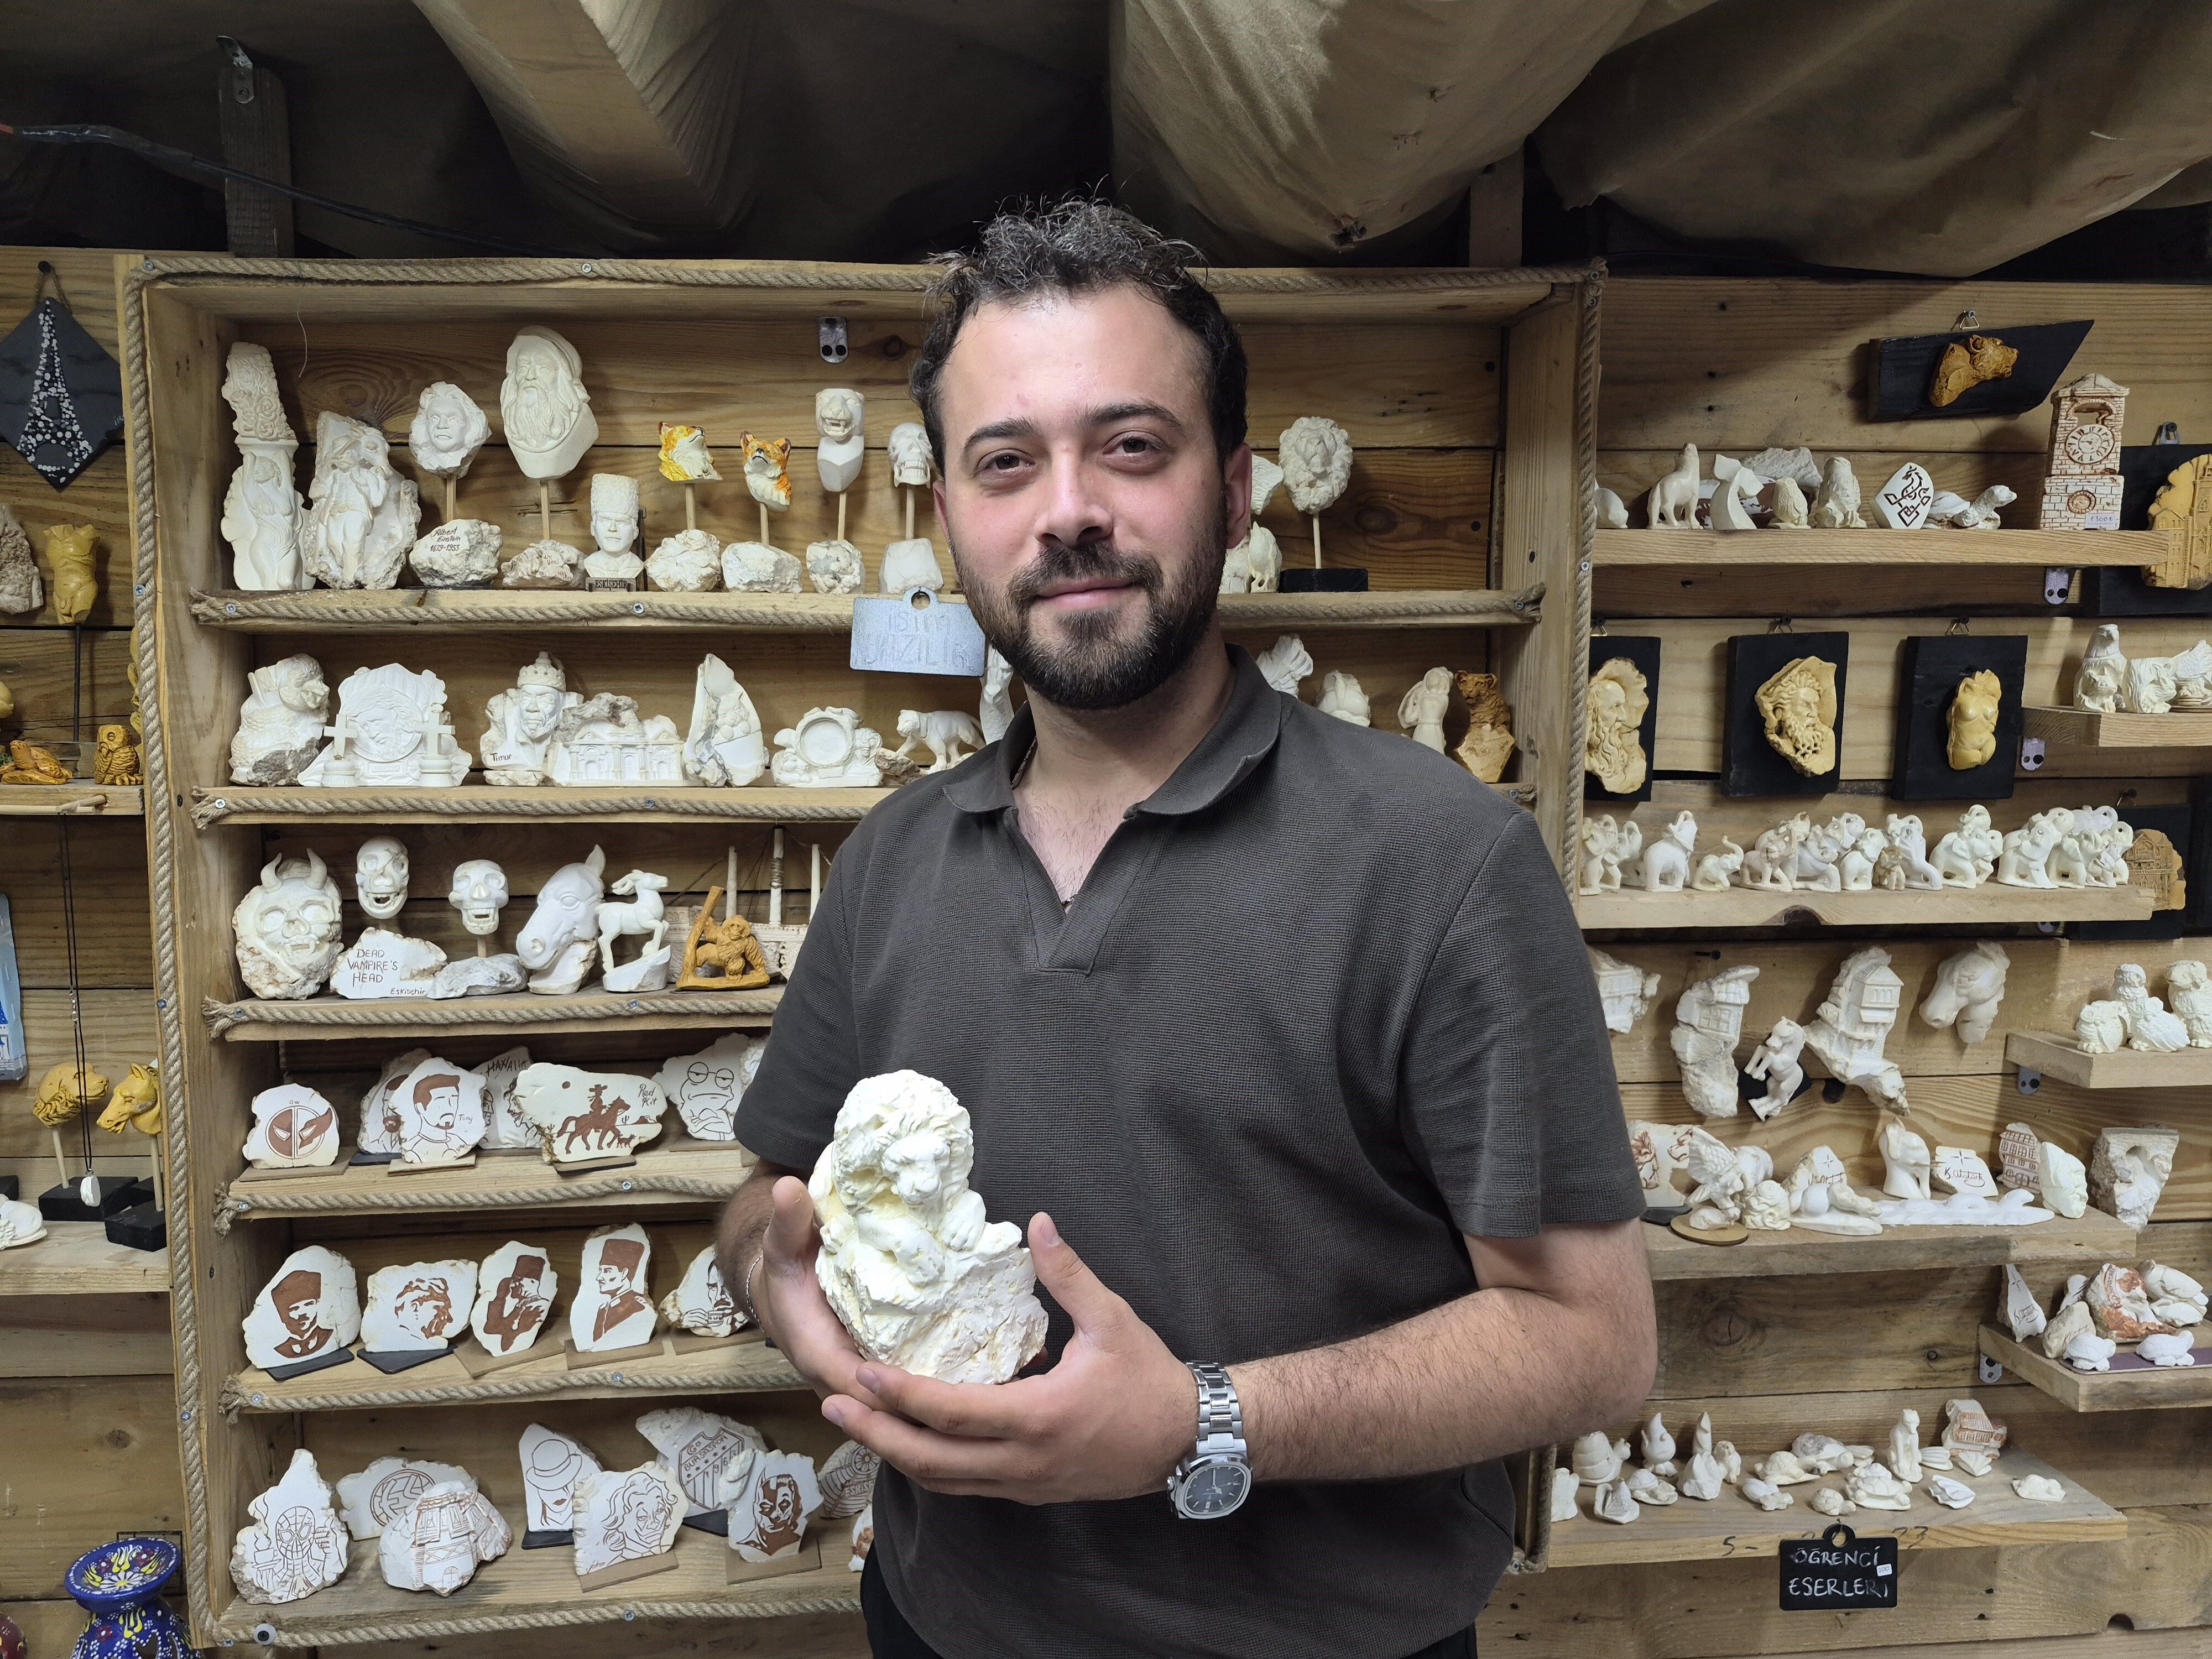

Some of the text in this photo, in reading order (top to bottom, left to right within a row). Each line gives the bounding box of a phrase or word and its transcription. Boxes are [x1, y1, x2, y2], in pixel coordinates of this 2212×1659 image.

[433, 526, 458, 537] Albert
[595, 578, 627, 591] ESKİŞEHİR
[490, 753, 513, 761] Timur
[357, 949, 385, 958] DEAD
[347, 958, 398, 973] VAMPIRE'S
[353, 972, 383, 987] HEAD
[638, 1083, 656, 1098] Red
[642, 1097, 659, 1108] Kit
[459, 1114, 473, 1124] Tony
[684, 1435, 728, 1472] BURSASPOR
